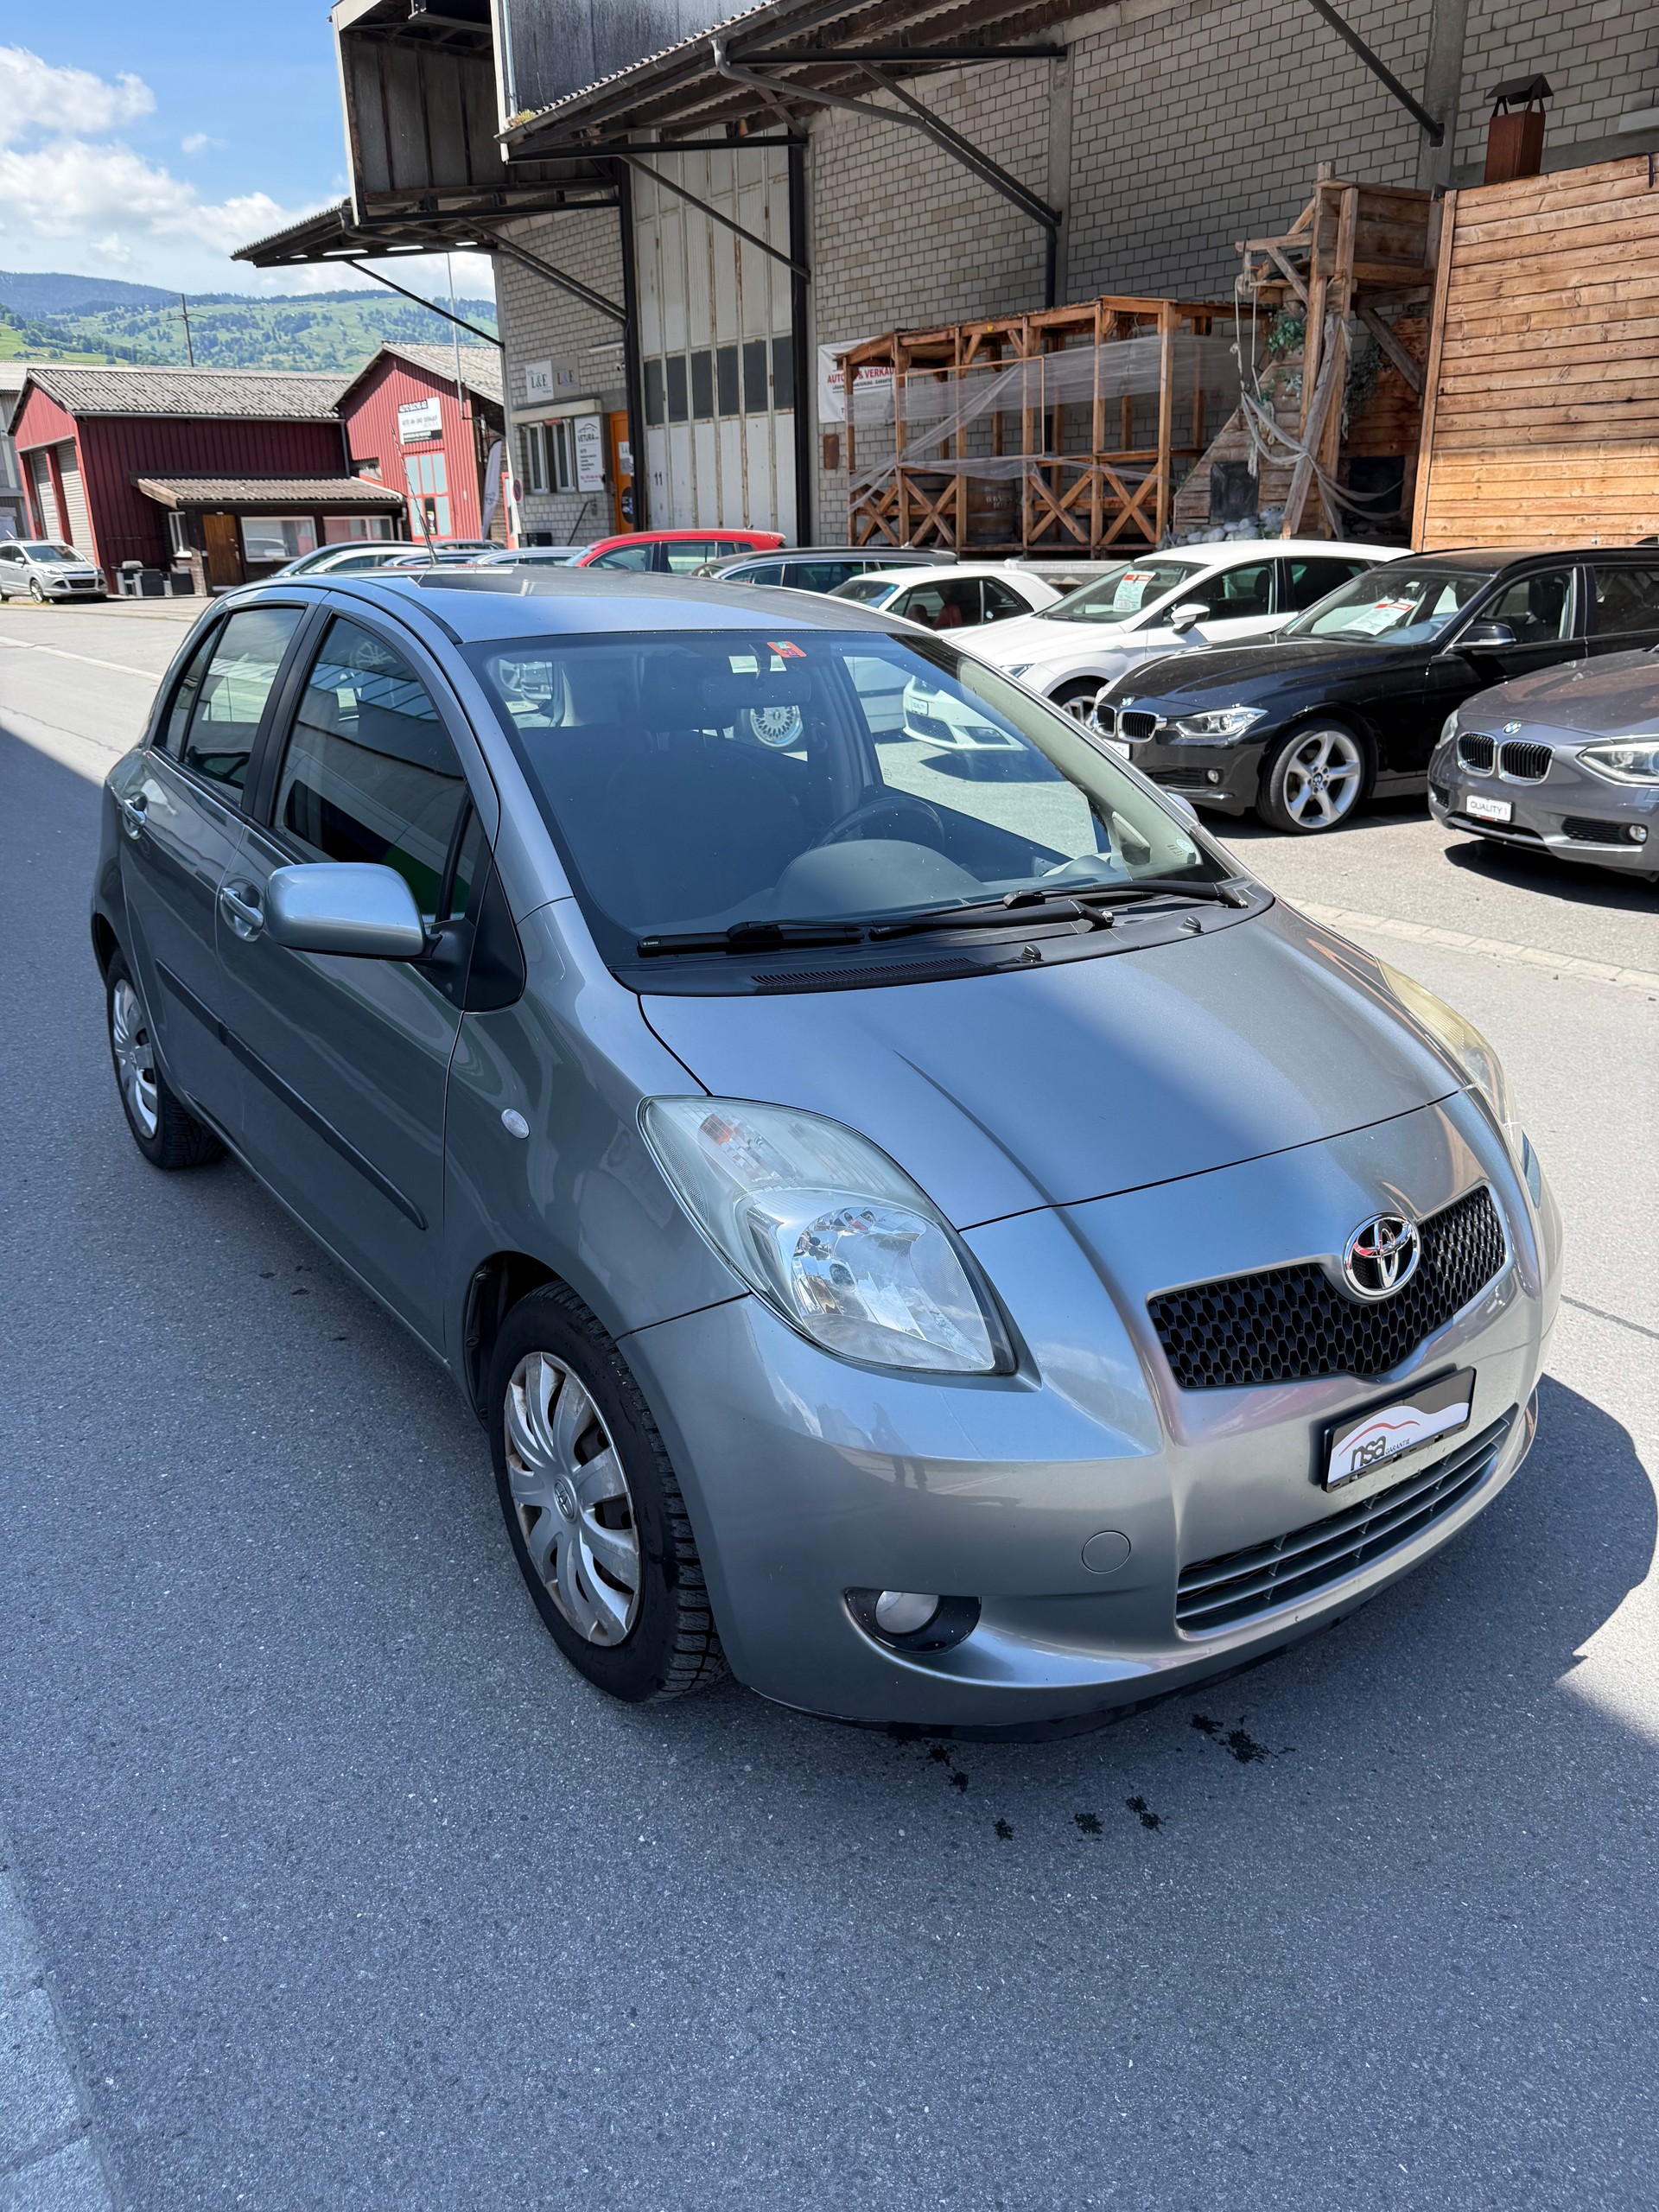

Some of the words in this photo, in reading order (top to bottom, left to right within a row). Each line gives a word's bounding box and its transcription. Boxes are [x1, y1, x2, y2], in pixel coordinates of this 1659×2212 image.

[865, 366, 894, 378] VERKAU
[531, 373, 548, 389] L&E
[654, 471, 663, 486] 11
[1471, 801, 1503, 814] QUALITY
[1351, 1435, 1387, 1471] nsa
[1385, 1438, 1410, 1455] GARANTIE
